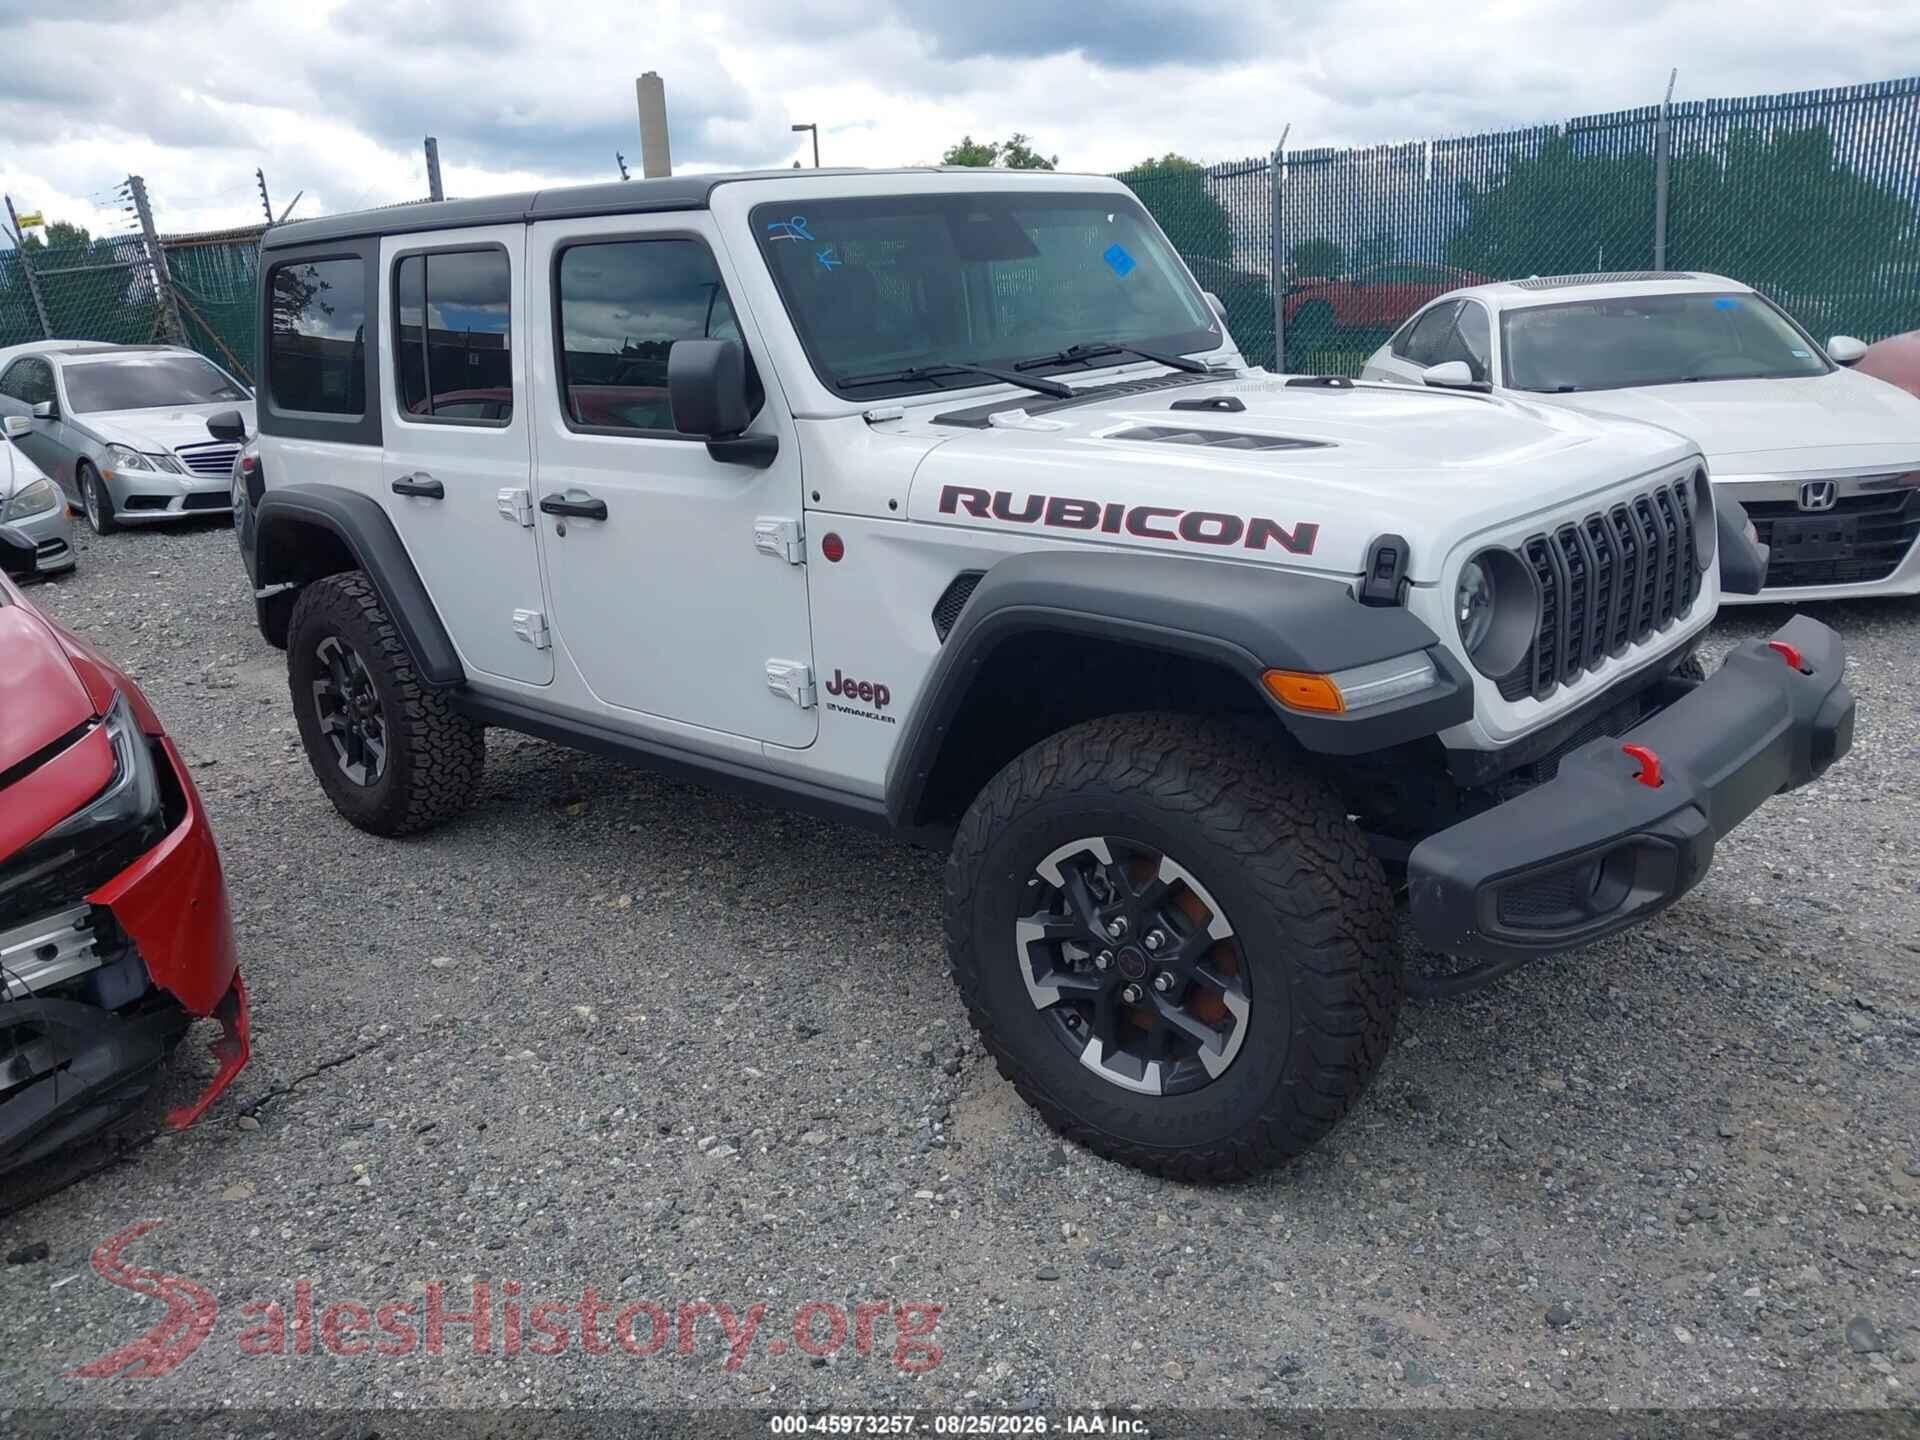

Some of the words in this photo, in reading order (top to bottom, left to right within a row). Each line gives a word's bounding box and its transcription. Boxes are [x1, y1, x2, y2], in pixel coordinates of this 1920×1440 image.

[939, 484, 1319, 555] RUBICON
[825, 668, 890, 709] Jeep
[837, 704, 896, 724] WRANGLER
